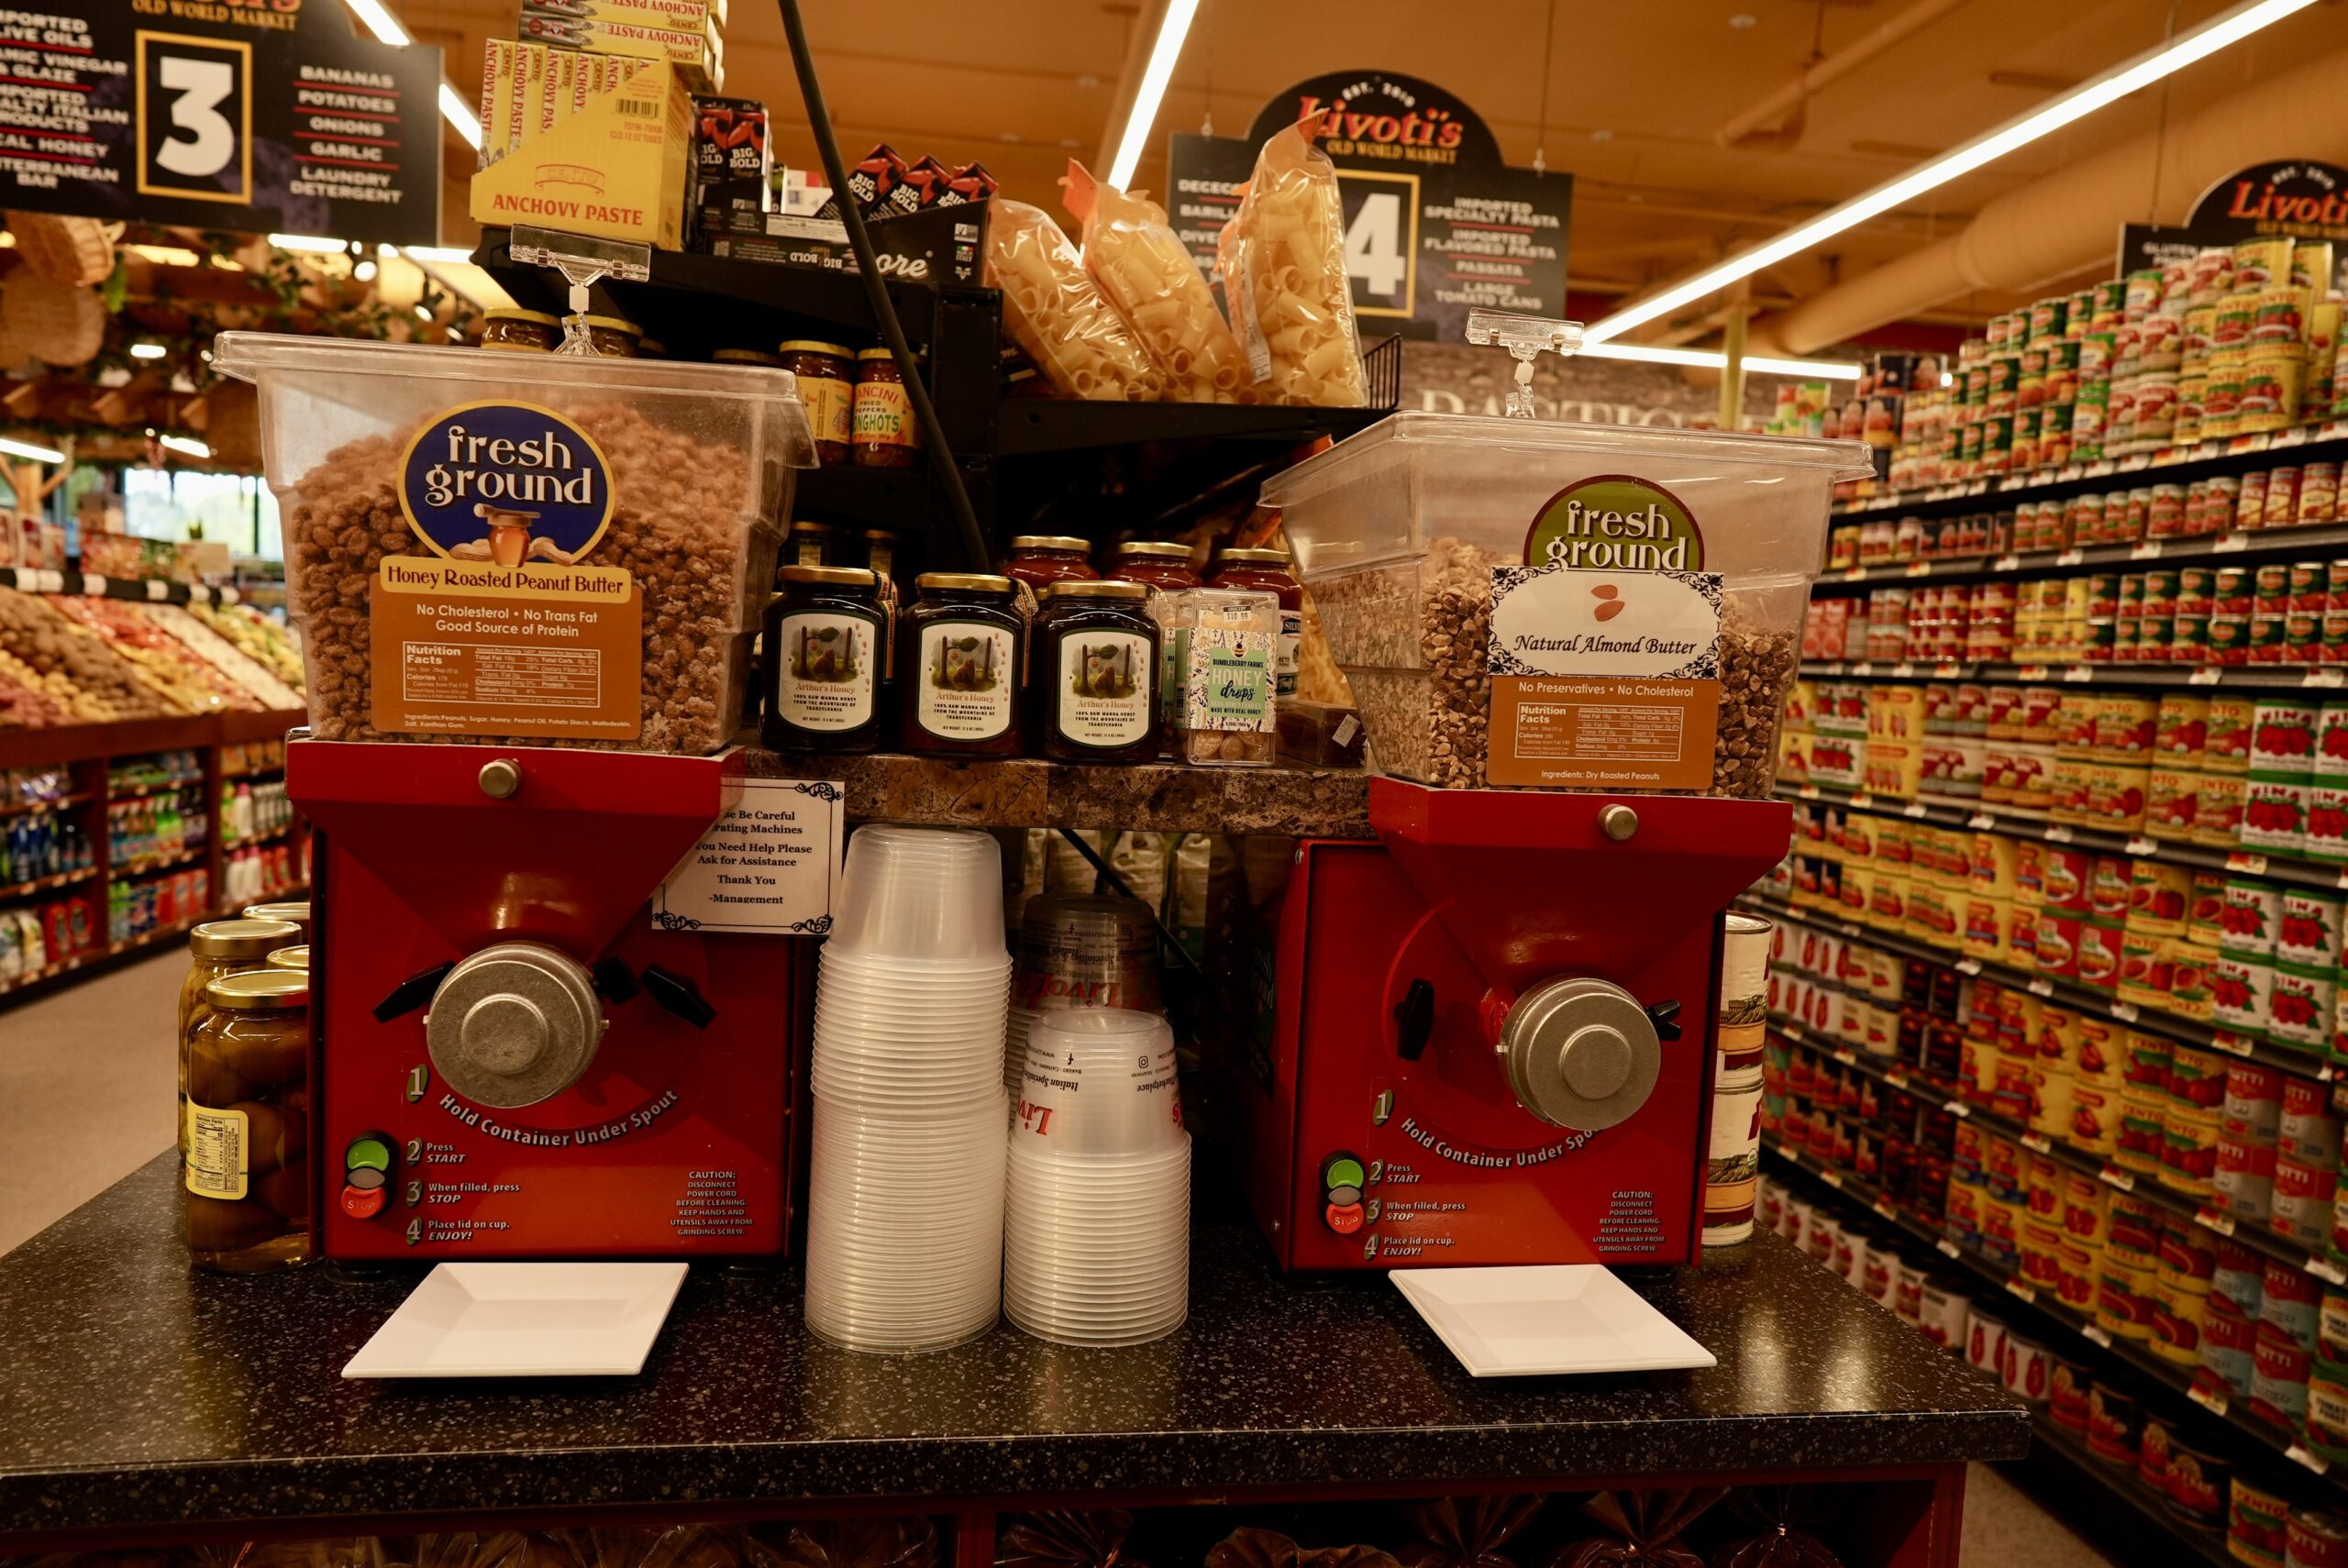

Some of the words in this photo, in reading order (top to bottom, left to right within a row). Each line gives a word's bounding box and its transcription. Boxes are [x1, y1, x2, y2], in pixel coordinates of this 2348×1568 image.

[170, 1, 229, 23] WORLD
[231, 7, 298, 31] MARKET
[607, 24, 644, 39] PASTE
[647, 28, 701, 47] ANCHOVY
[300, 65, 394, 89] BANANAS
[482, 40, 497, 97] ANCHOVY
[298, 90, 396, 113] POTATOES
[156, 56, 235, 177] 3
[481, 97, 494, 134] PASTE
[1298, 95, 1463, 149] Livoti's
[309, 116, 384, 137] ONIONS
[310, 141, 383, 161] GARLIC
[732, 147, 753, 158] BIG
[1326, 139, 1355, 156] OLD
[1357, 141, 1403, 160] WORLD
[1404, 146, 1457, 165] MARKET
[729, 158, 760, 169] BOLD
[301, 165, 391, 188] LAUNDRY
[289, 180, 404, 204] DETERGENT
[493, 194, 580, 219] ANCHOVY
[585, 204, 643, 226] PASTE
[1454, 197, 1533, 215] IMPORTED
[1424, 205, 1508, 224] SPECIALTY
[1511, 213, 1560, 228] PASTA
[1346, 193, 1405, 295] 4
[1452, 229, 1531, 247] IMPORTED
[1423, 237, 1505, 256] FLAVORED
[1507, 244, 1556, 259] PASTA
[1456, 259, 1523, 277] PASSATA
[1463, 282, 1516, 296] LARGE
[1434, 289, 1497, 306] TOMATO
[1499, 294, 1542, 310] CANS
[856, 386, 899, 404] ANCINI
[853, 414, 900, 433] NGHOTS
[448, 425, 572, 470] fresh
[425, 463, 593, 506] ground
[1567, 500, 1672, 539] fresh
[1545, 536, 1688, 571] ground
[388, 566, 439, 589] Honey
[445, 569, 511, 589] Roasted
[515, 572, 571, 591] Peanut
[575, 575, 624, 593] Butter
[416, 604, 435, 615] No
[437, 605, 509, 619] Cholesterol
[524, 609, 542, 621] No
[545, 610, 576, 623] Trans
[580, 612, 597, 624] Fat
[436, 620, 471, 633] Good
[475, 623, 518, 634] Source
[522, 623, 535, 635] of
[537, 624, 579, 636] Protein
[406, 645, 461, 657] Nutrition
[1513, 635, 1581, 652] Natural
[1578, 635, 1641, 654] Almond
[1645, 638, 1697, 655] Butter
[406, 655, 443, 666] Facts
[1213, 659, 1247, 668] BUMBLEBERRY
[1212, 668, 1263, 687] HONEY
[795, 682, 828, 691] Arthur's
[830, 685, 856, 694] Honey
[1220, 679, 1255, 702] drops
[1519, 682, 1534, 693] No
[1536, 683, 1605, 695] Preservatives
[1617, 685, 1634, 695] No
[1635, 685, 1693, 697] Cholesterol
[1077, 700, 1110, 709] Arthur's
[1111, 701, 1135, 710] Honey
[1520, 705, 1567, 716] Nutrition
[1520, 714, 1550, 723] Facts
[1541, 770, 1584, 779] Ingredients:
[1586, 771, 1599, 780] Dry
[1600, 771, 1630, 779] Roasted
[1632, 771, 1660, 780] Peanuts
[739, 811, 752, 819] Be
[755, 811, 795, 821] Careful
[713, 824, 748, 834] rating
[750, 824, 803, 834] Machines
[718, 843, 746, 852] Need
[748, 843, 775, 855] Help
[778, 844, 813, 854] Please
[698, 856, 718, 865] Ask
[720, 856, 737, 865] for
[739, 856, 797, 867] Assistance
[717, 875, 751, 885] Thank
[755, 876, 776, 885] You
[708, 893, 783, 904] -Management
[409, 1067, 424, 1096] 1
[1050, 1078, 1079, 1092] Italian
[1377, 1093, 1389, 1119] 1
[439, 1093, 480, 1127] Hold
[481, 1119, 570, 1147] Container
[574, 1121, 628, 1145] Under
[630, 1089, 679, 1129] Spout
[406, 1140, 420, 1162] 2
[426, 1143, 453, 1152] Press
[1401, 1117, 1435, 1148] Hold
[1435, 1142, 1512, 1167] Container
[1516, 1143, 1563, 1167] Under
[1566, 1130, 1600, 1150] Spo
[426, 1154, 466, 1163] START
[689, 1171, 736, 1179] CAUTION:
[1369, 1161, 1381, 1181] 2
[1388, 1164, 1411, 1172] Press
[1387, 1174, 1421, 1183] START
[406, 1181, 420, 1202] 3
[428, 1183, 457, 1191] When
[460, 1183, 491, 1193] filled,
[493, 1185, 520, 1194] press
[428, 1195, 461, 1203] STOP
[1387, 1201, 1412, 1209] When
[1413, 1201, 1440, 1210] filled,
[1443, 1203, 1466, 1211] press
[1367, 1199, 1379, 1219] 3
[1386, 1212, 1414, 1220] STOP
[406, 1219, 420, 1241] 4
[428, 1220, 455, 1229] Place
[458, 1220, 472, 1229] lid
[489, 1222, 510, 1231] cup.
[428, 1231, 472, 1241] ENJOY!
[1365, 1235, 1377, 1255] 4
[1384, 1236, 1407, 1244] Place
[1410, 1236, 1421, 1244] lid
[1436, 1238, 1455, 1246] cup.
[1383, 1247, 1422, 1255] ENJOY!
